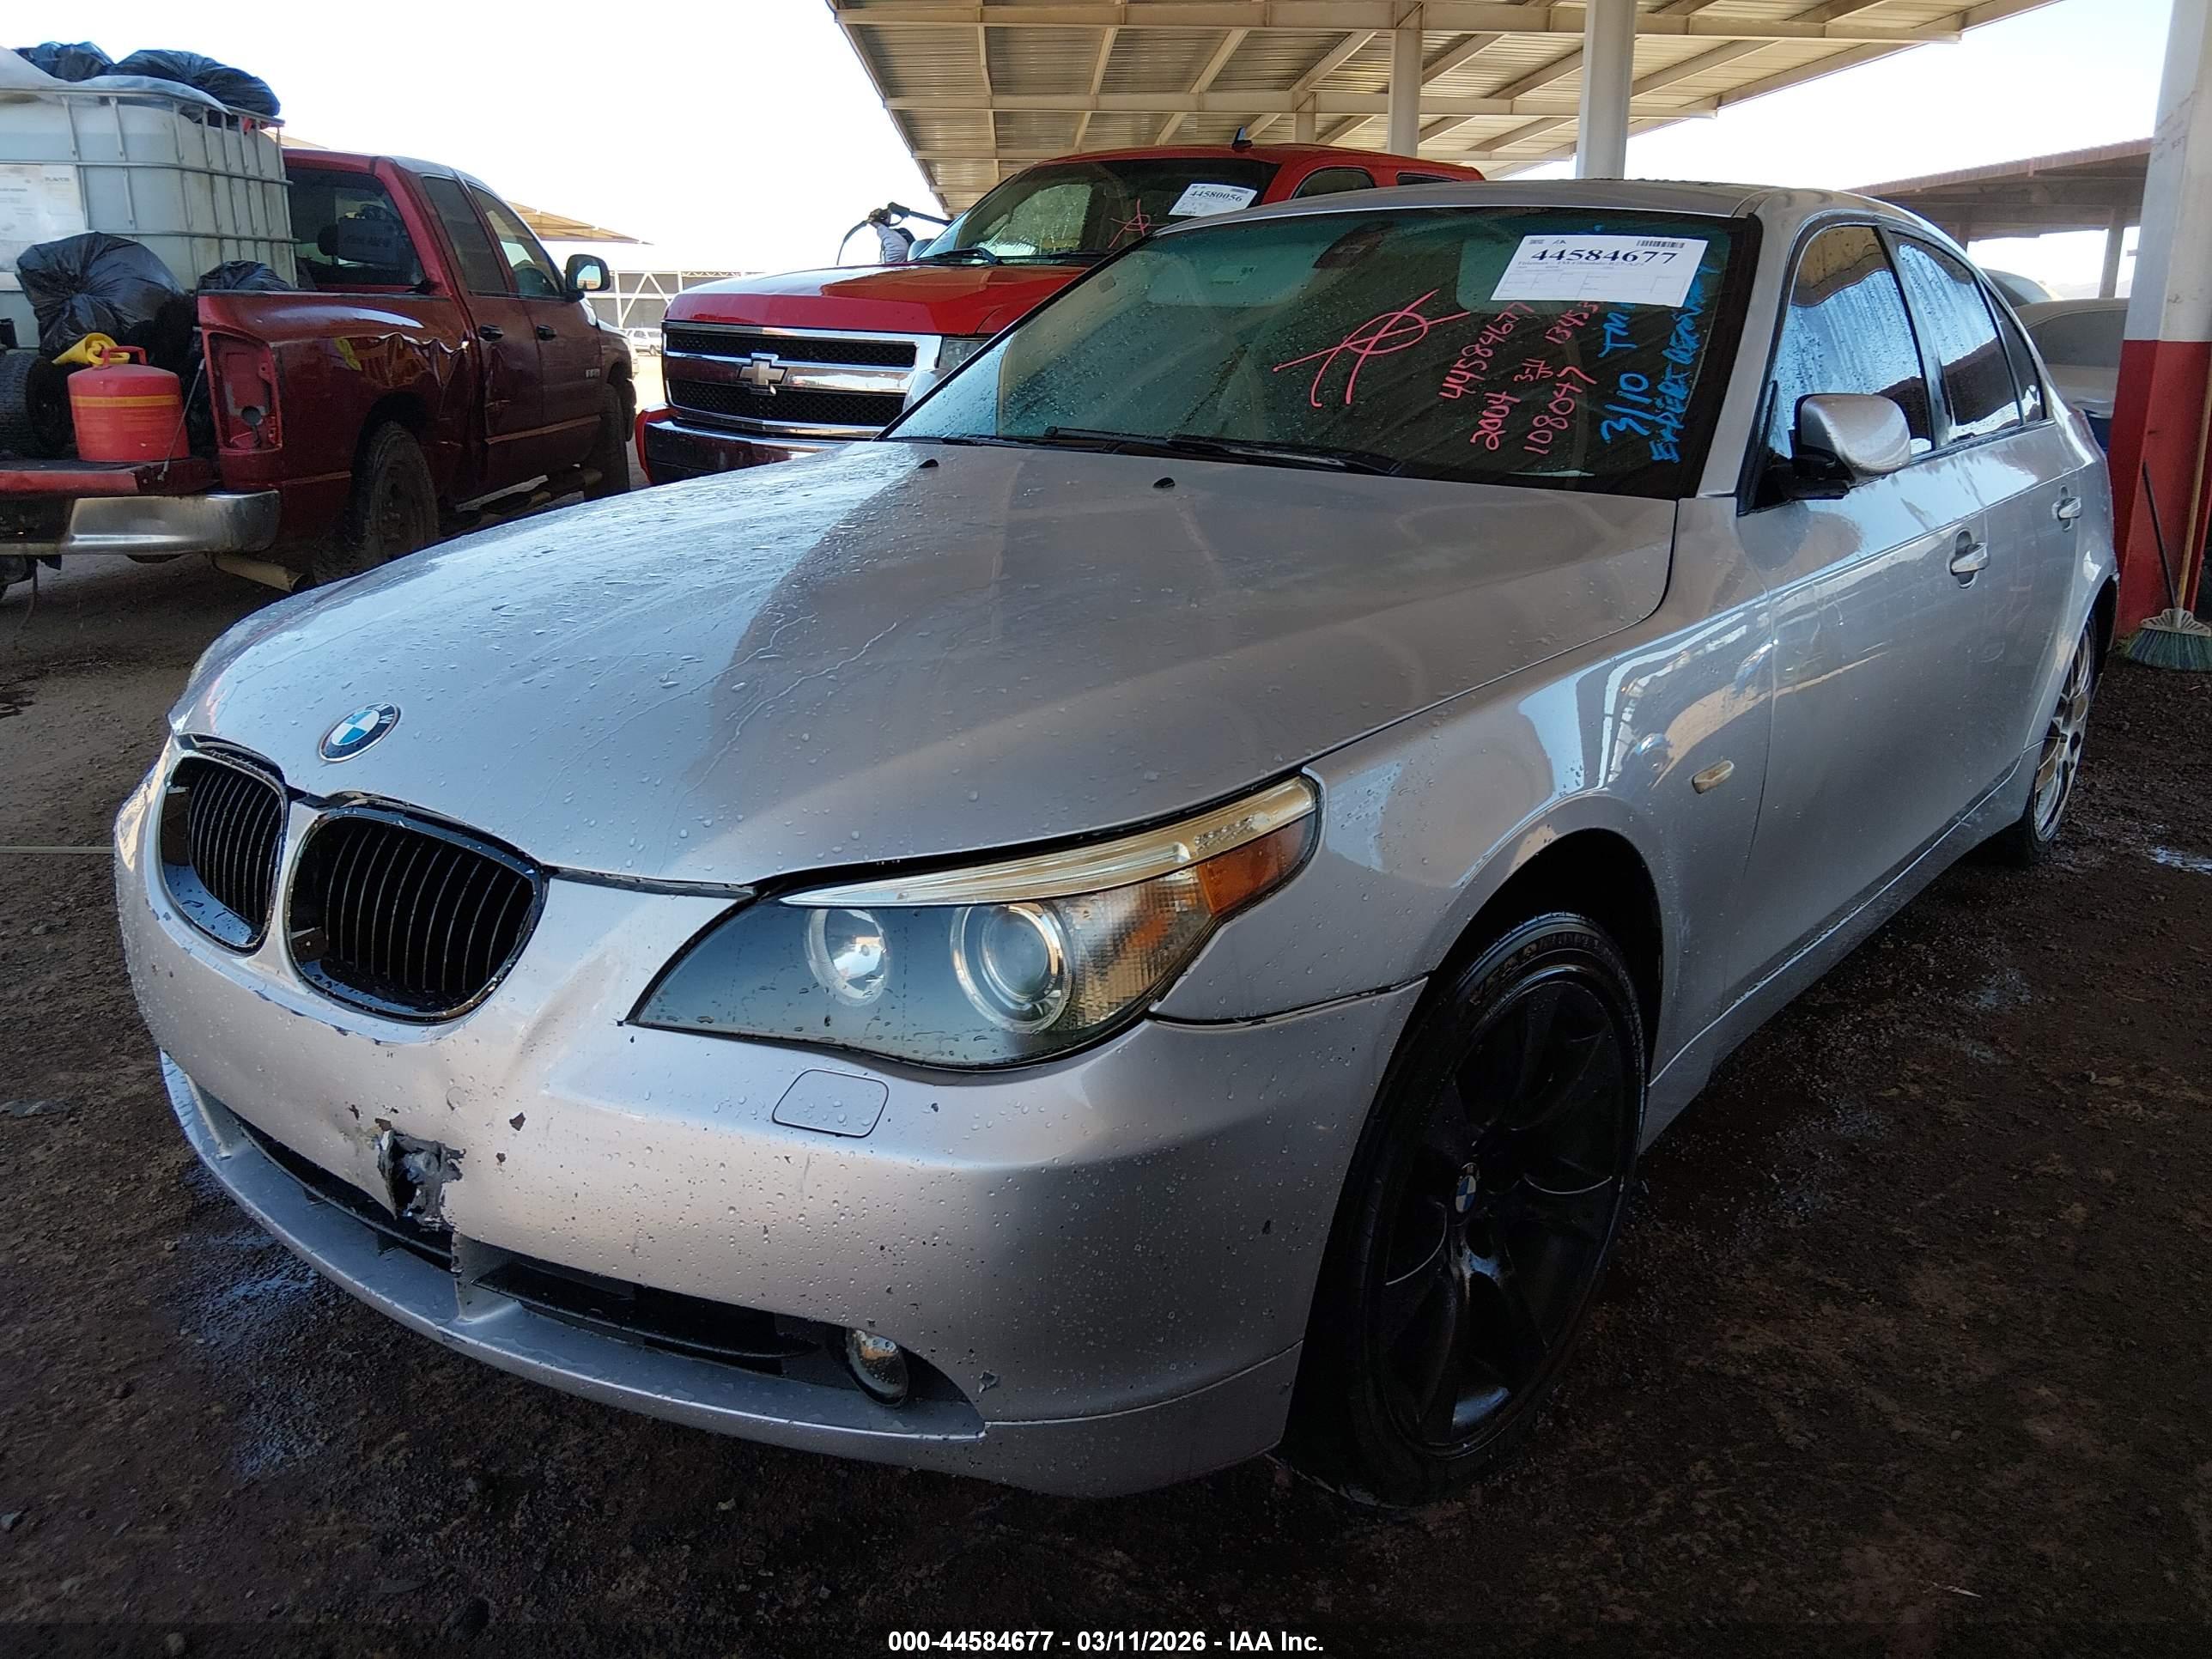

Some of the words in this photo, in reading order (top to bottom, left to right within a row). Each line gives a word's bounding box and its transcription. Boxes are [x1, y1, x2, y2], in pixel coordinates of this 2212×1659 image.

[1189, 191, 1243, 202] 44580056
[1531, 249, 1677, 264] 44584677
[1439, 301, 1534, 398] 44584677
[1470, 392, 1522, 451] 2004
[1523, 366, 1598, 455] 108047
[1601, 373, 1656, 444] 3/10
